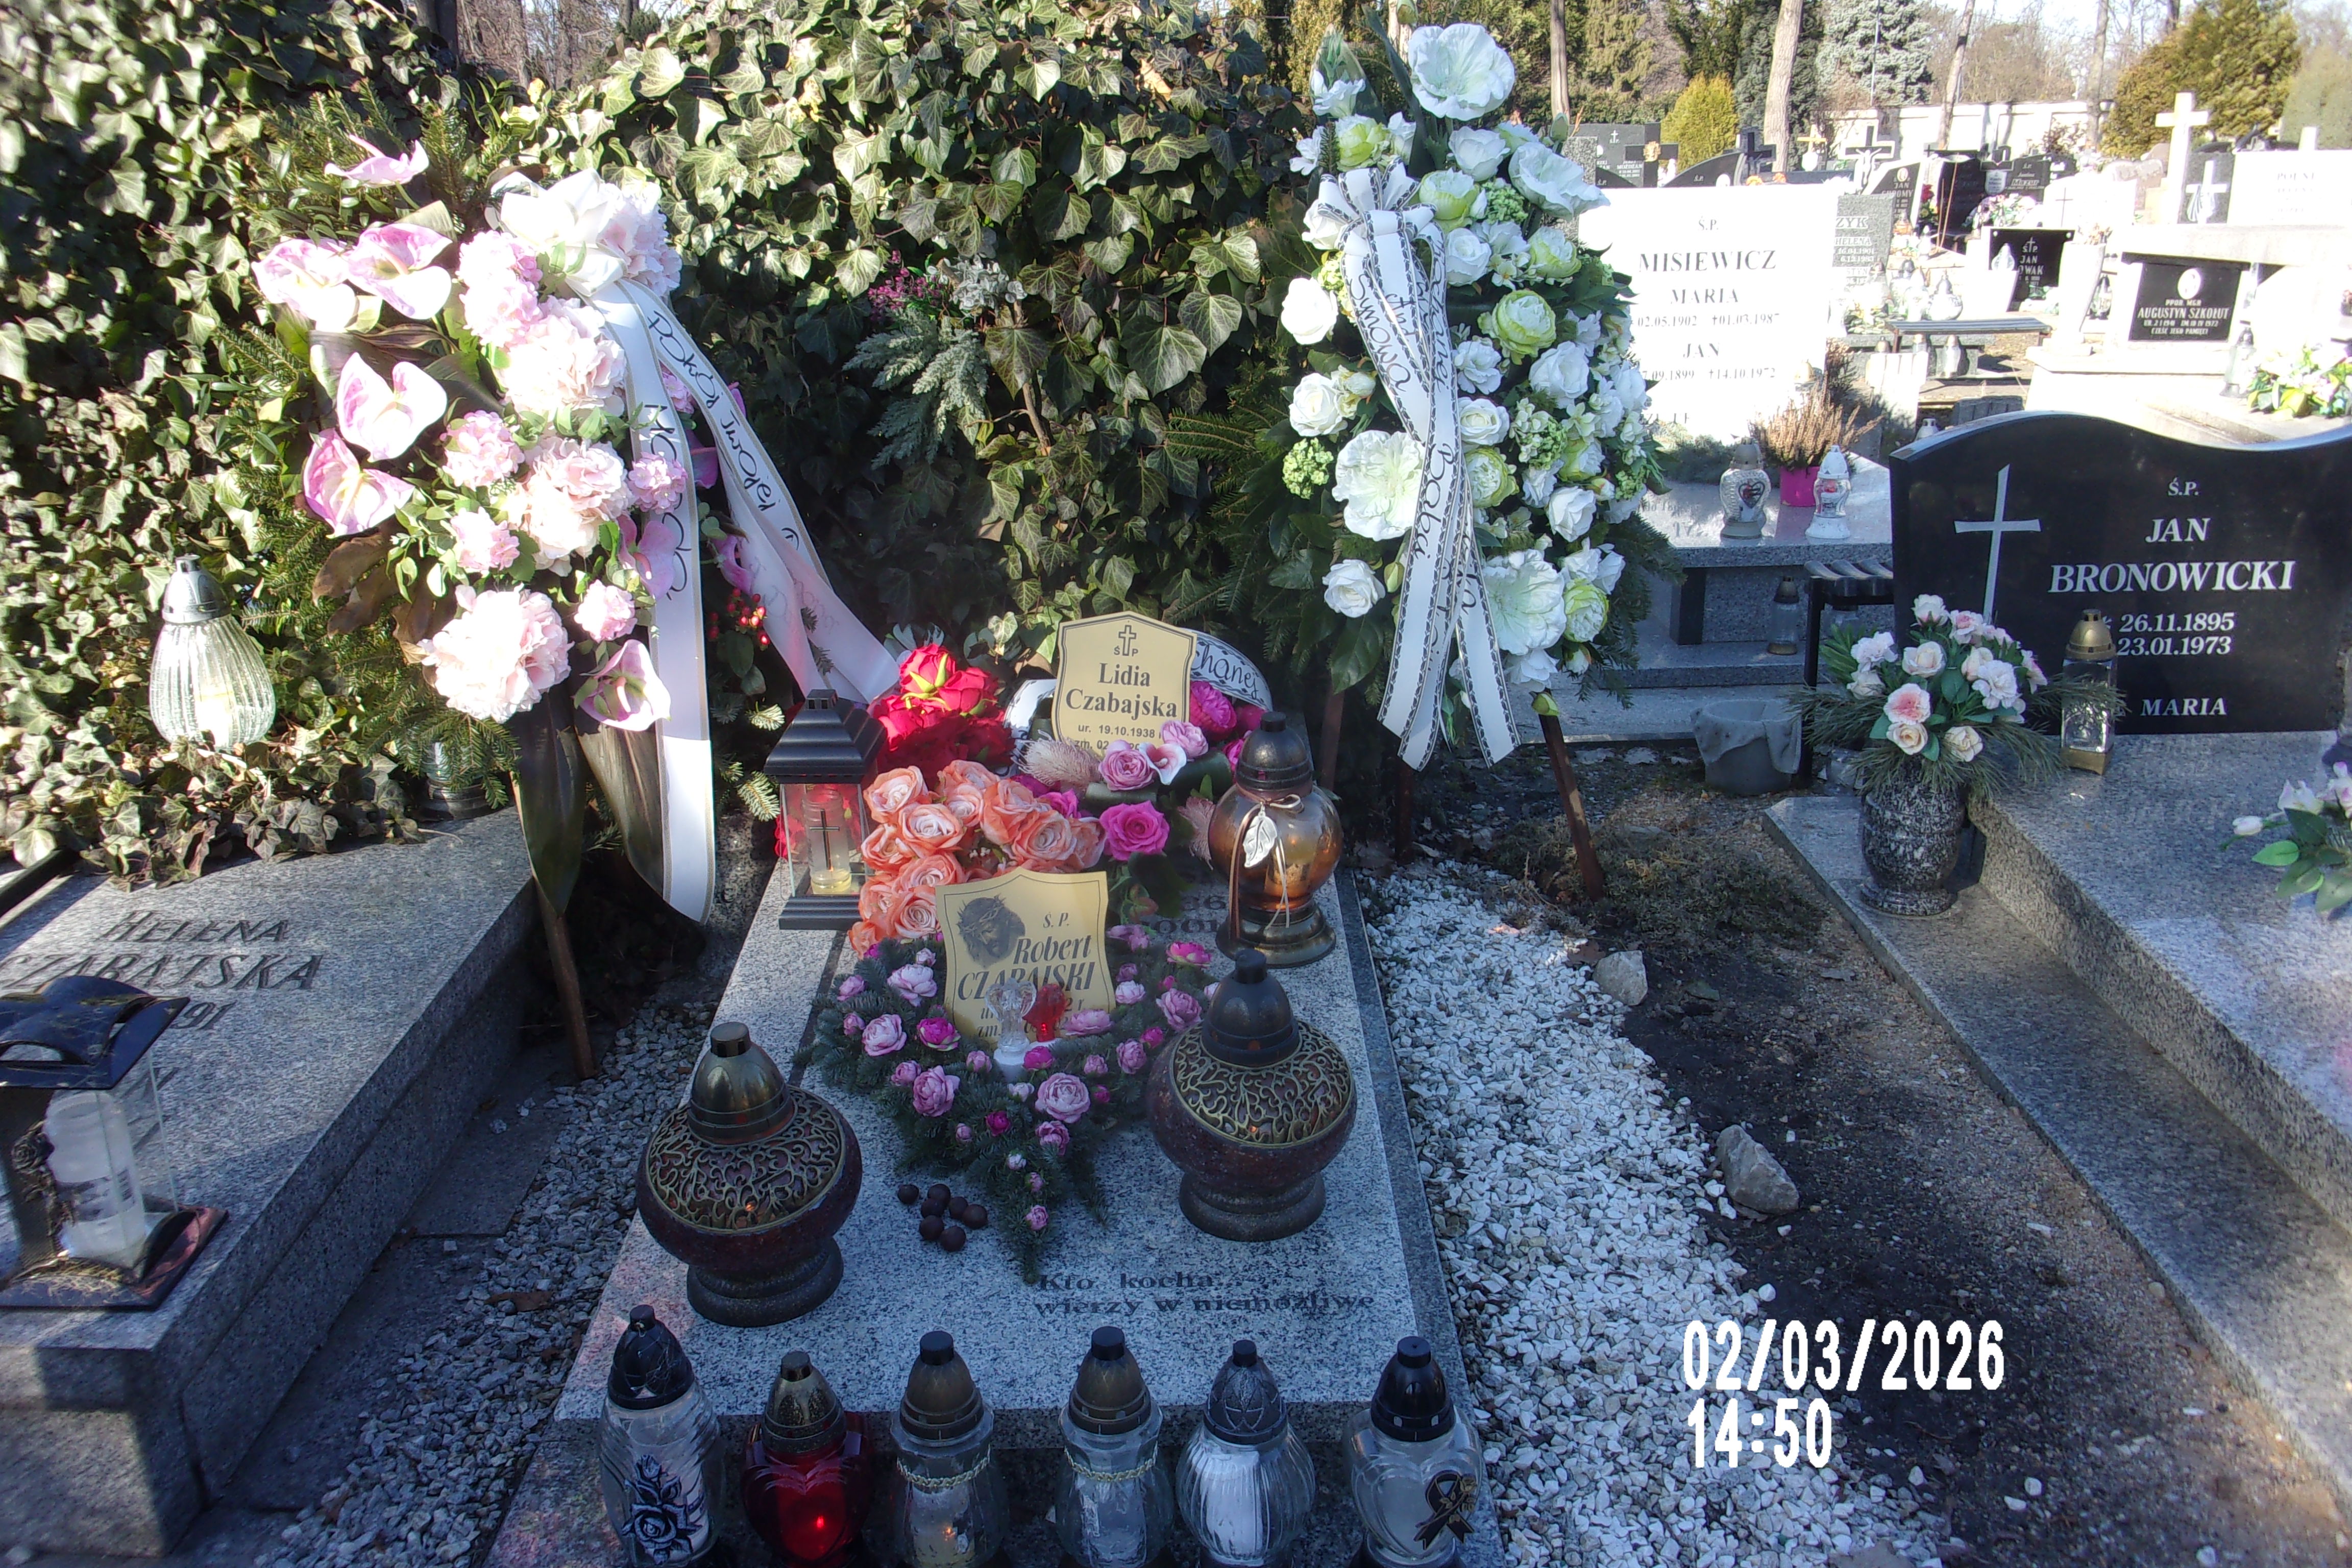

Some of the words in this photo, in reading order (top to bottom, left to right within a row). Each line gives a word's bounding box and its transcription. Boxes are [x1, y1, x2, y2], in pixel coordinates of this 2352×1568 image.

[1698, 216, 1719, 231] Ś.P.
[1836, 217, 1868, 228] ZYK
[1835, 237, 1871, 246] HELENA
[1638, 250, 1777, 273] MISIEWICZ
[2018, 265, 2044, 275] OWAK
[1670, 288, 1739, 305] MARIA
[1637, 315, 1698, 328] 02.05.1902
[2137, 307, 2187, 319] AUGUSTYN
[1682, 342, 1720, 358] JAN
[1642, 369, 1695, 381] 7.09.1899
[2167, 476, 2199, 497] Ś.P.
[1414, 443, 1456, 560] Babci
[2145, 518, 2211, 544] JAN
[2048, 560, 2296, 594] BRONOWICKI
[2119, 612, 2235, 632] 26.11.1895
[2116, 636, 2232, 656] 23.01.1973
[1098, 663, 1151, 687] Lidia
[1192, 643, 1259, 700] chanej
[1065, 688, 1178, 721] Czabajska
[2140, 697, 2227, 716] MARIA
[1078, 724, 1091, 732] ur.
[1099, 724, 1155, 739] 19.10.1938
[102, 911, 290, 943] HELENA
[1013, 935, 1092, 966] Robert
[1039, 1272, 1095, 1291] Kto
[1035, 1298, 1142, 1316] wierzy
[1155, 1300, 1183, 1313] w
